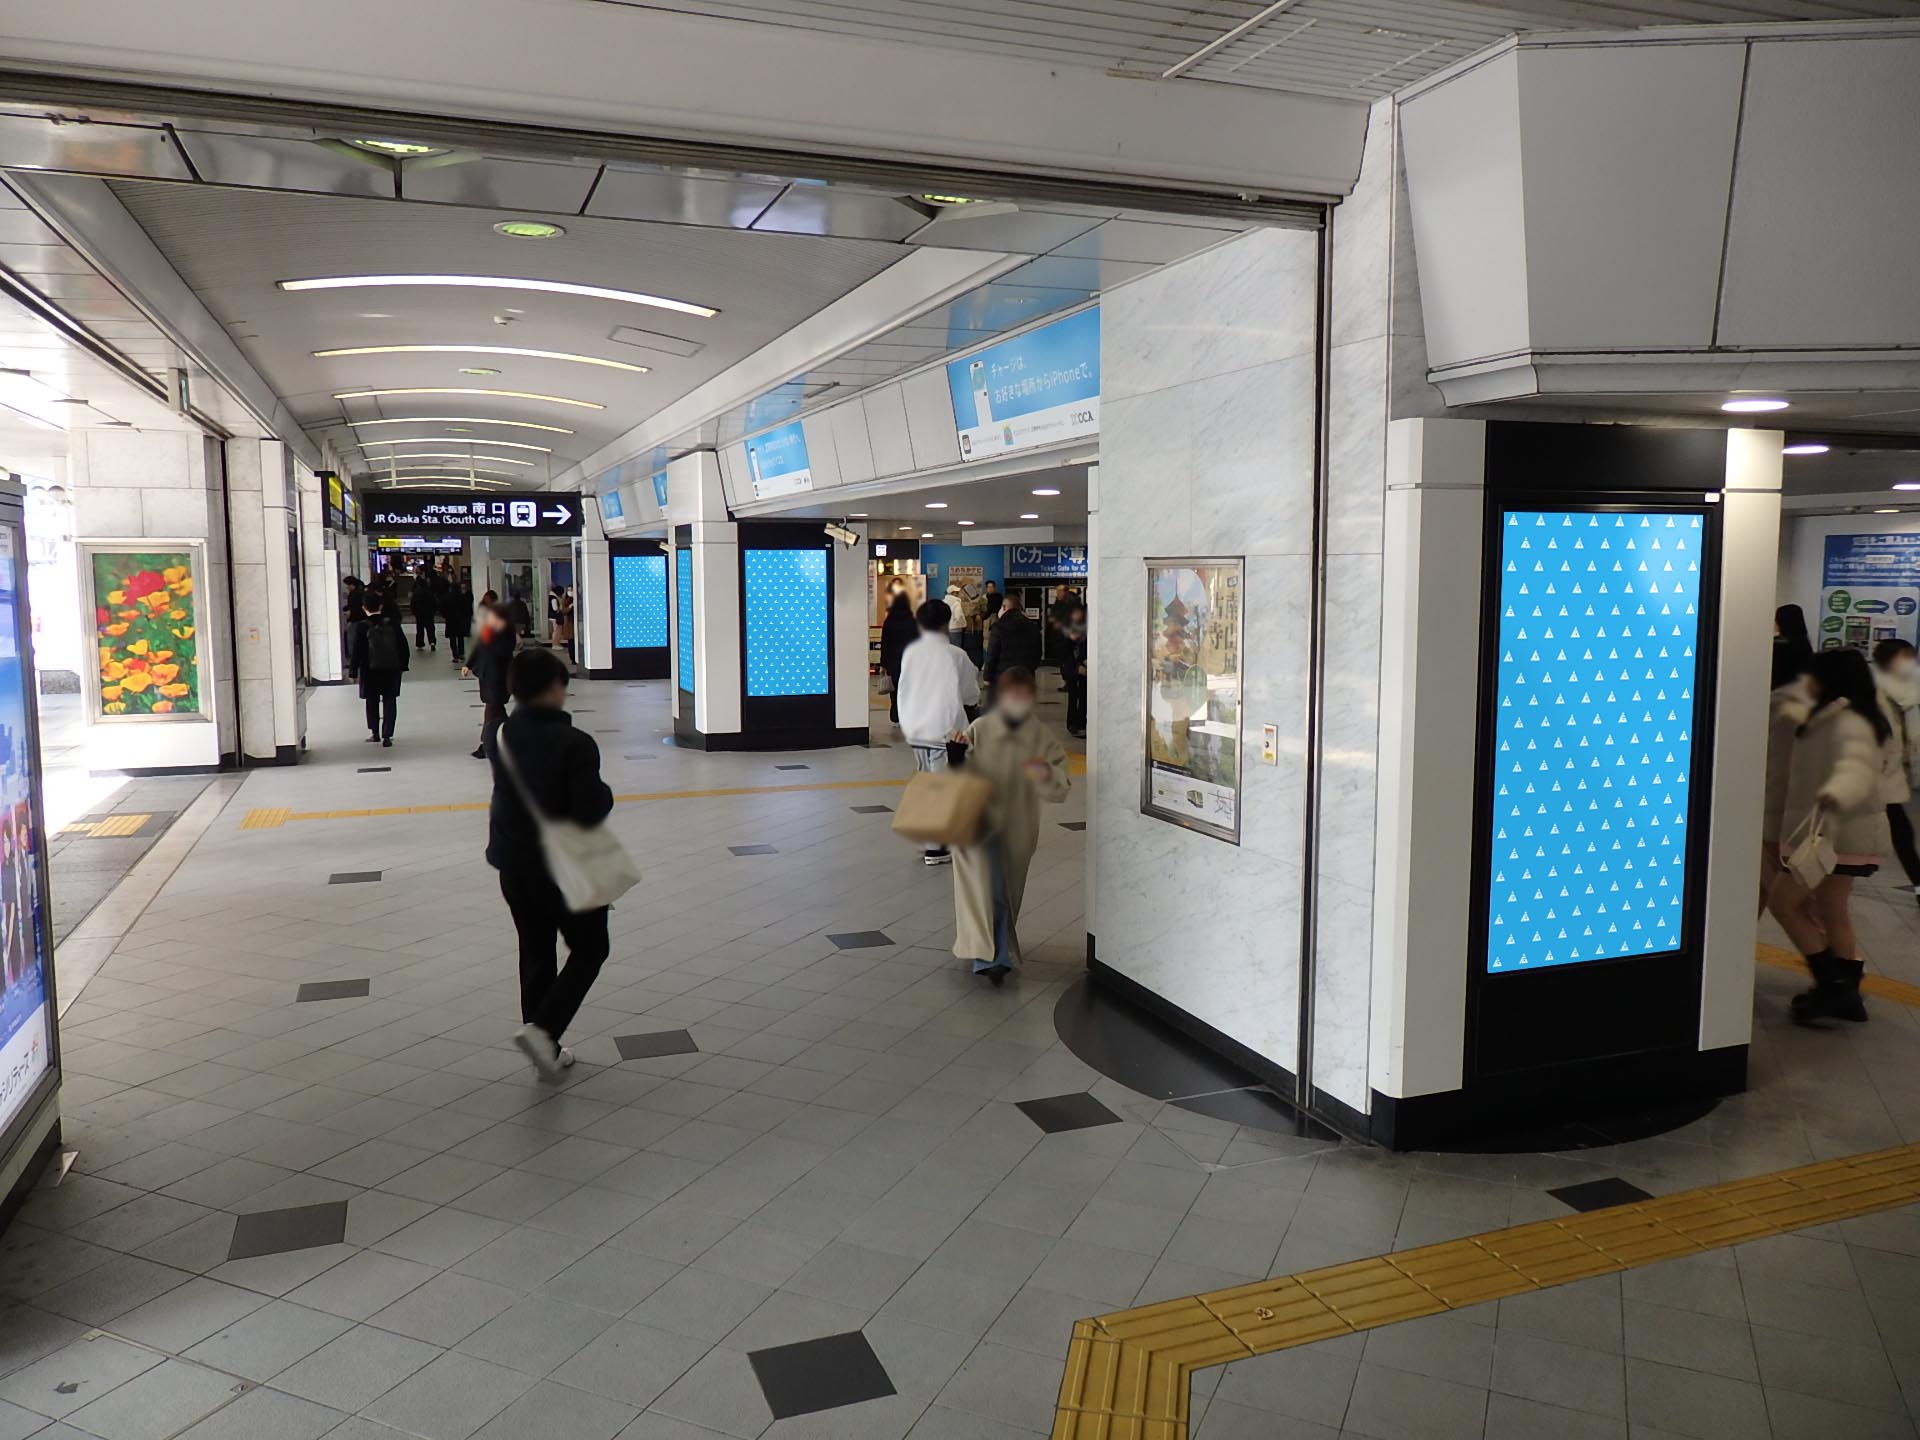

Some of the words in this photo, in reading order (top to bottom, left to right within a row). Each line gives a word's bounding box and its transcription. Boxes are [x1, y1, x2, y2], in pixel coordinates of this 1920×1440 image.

[422, 505, 468, 514] JR大阪駅
[472, 502, 505, 515] 南口
[373, 514, 386, 524] JR
[387, 512, 420, 524] Ōsaka
[421, 514, 441, 525] Sta.
[442, 514, 476, 526] (South
[477, 515, 505, 526] Gate)
[1012, 546, 1088, 564] ICカード専
